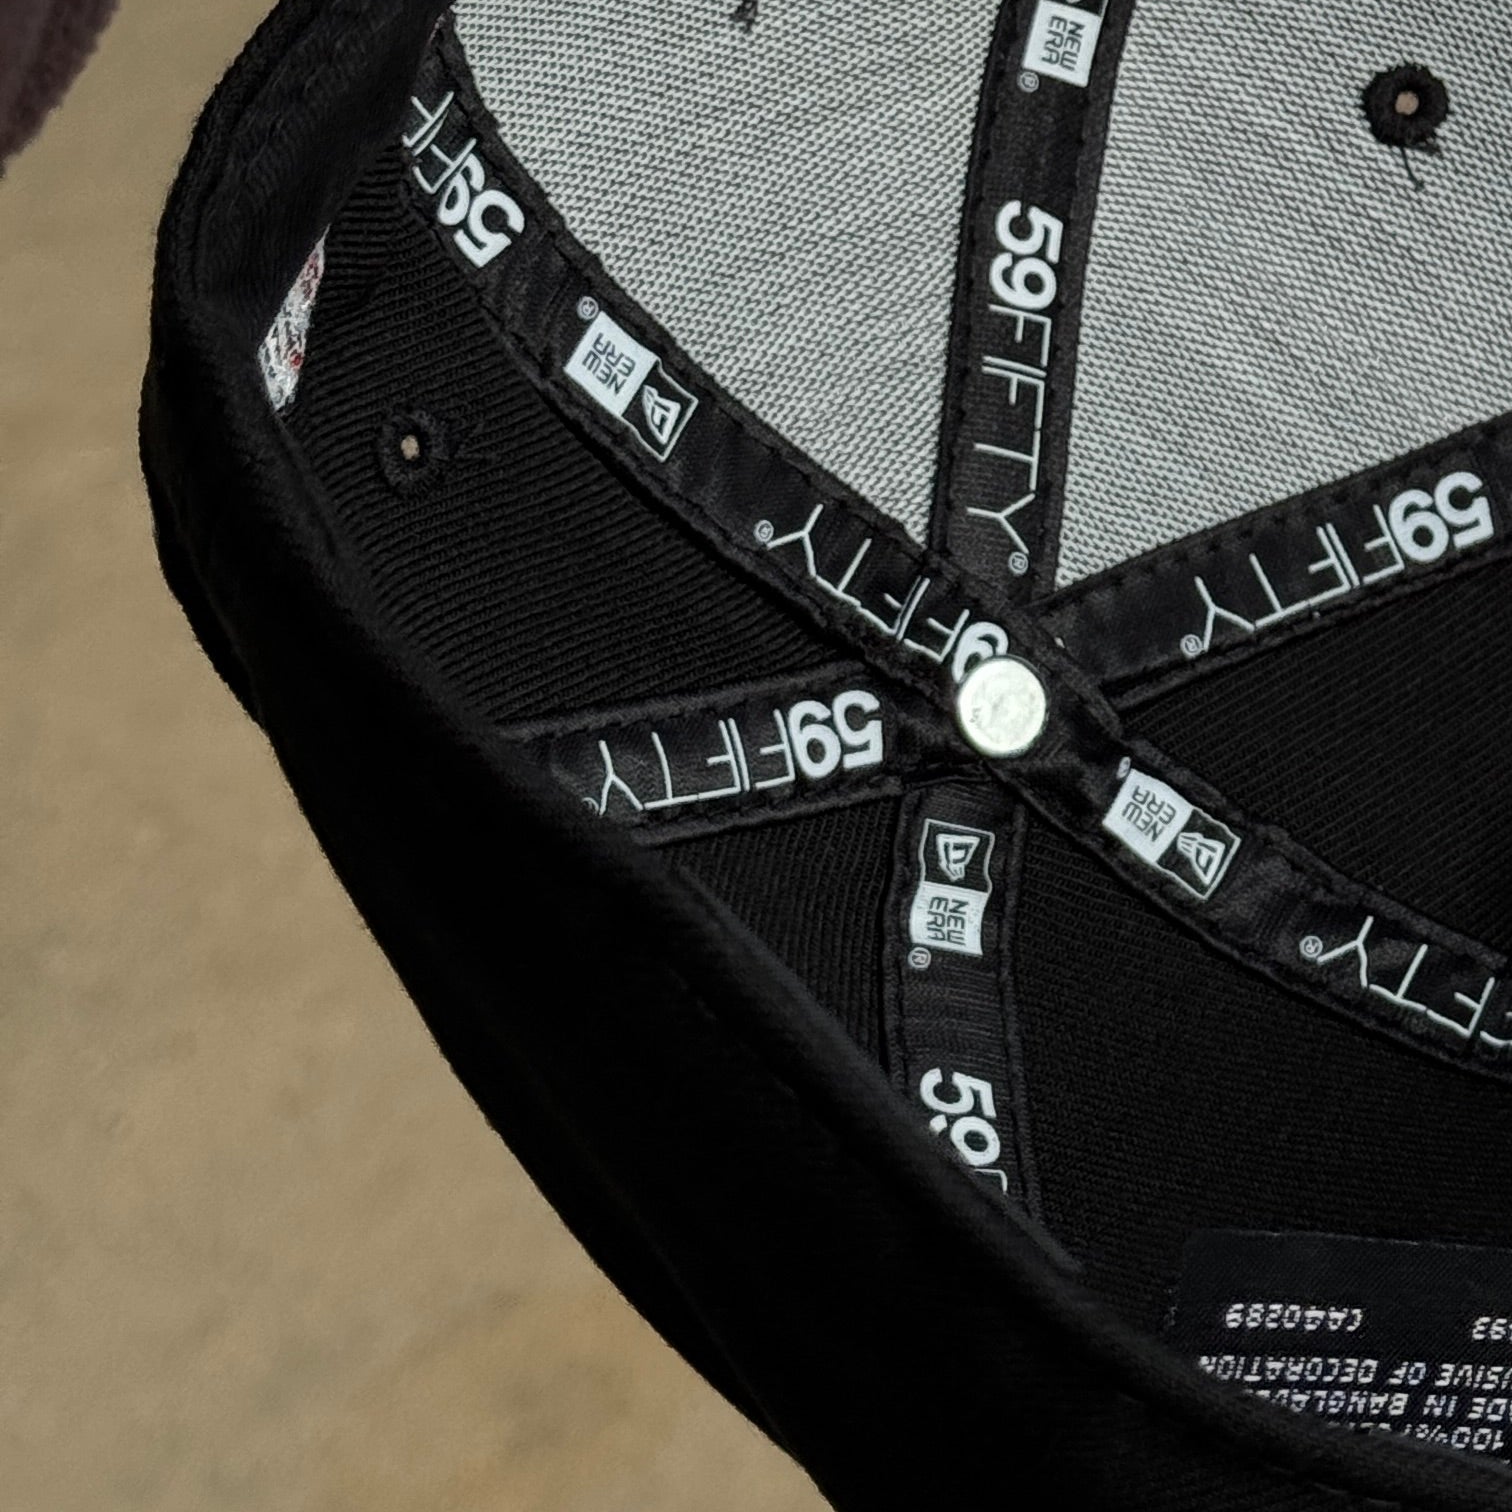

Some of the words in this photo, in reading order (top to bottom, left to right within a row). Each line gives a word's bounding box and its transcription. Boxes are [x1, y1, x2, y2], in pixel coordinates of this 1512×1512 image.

[1041, 14, 1069, 66] ERA
[1058, 19, 1086, 72] NEW
[581, 350, 627, 395] NEW
[591, 332, 637, 378] ERA
[765, 503, 1010, 684] 9FIFTY
[1121, 801, 1165, 843] NEW
[1131, 784, 1177, 825] ERA
[926, 895, 949, 942] ERA
[946, 898, 969, 947] NEW
[1386, 1360, 1427, 1387] OF
[1422, 1392, 1459, 1419] IN
